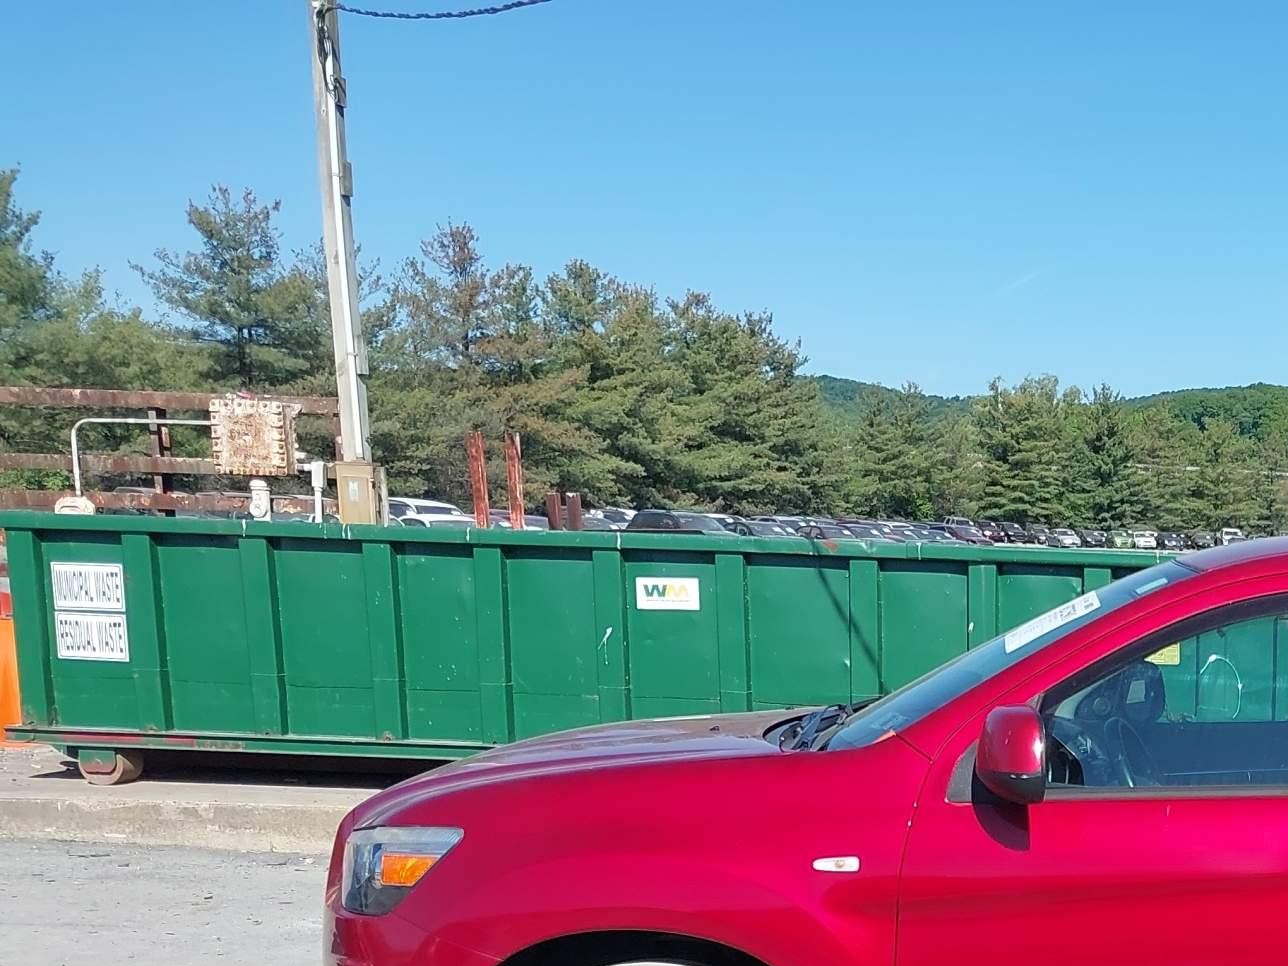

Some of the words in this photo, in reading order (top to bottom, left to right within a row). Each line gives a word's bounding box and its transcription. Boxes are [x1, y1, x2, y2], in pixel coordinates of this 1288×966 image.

[55, 569, 94, 602] MUNICIPAL
[94, 571, 120, 603] WASTE
[643, 584, 688, 598] WM
[59, 619, 97, 652] RESIDUAL
[97, 621, 124, 654] WASTE
